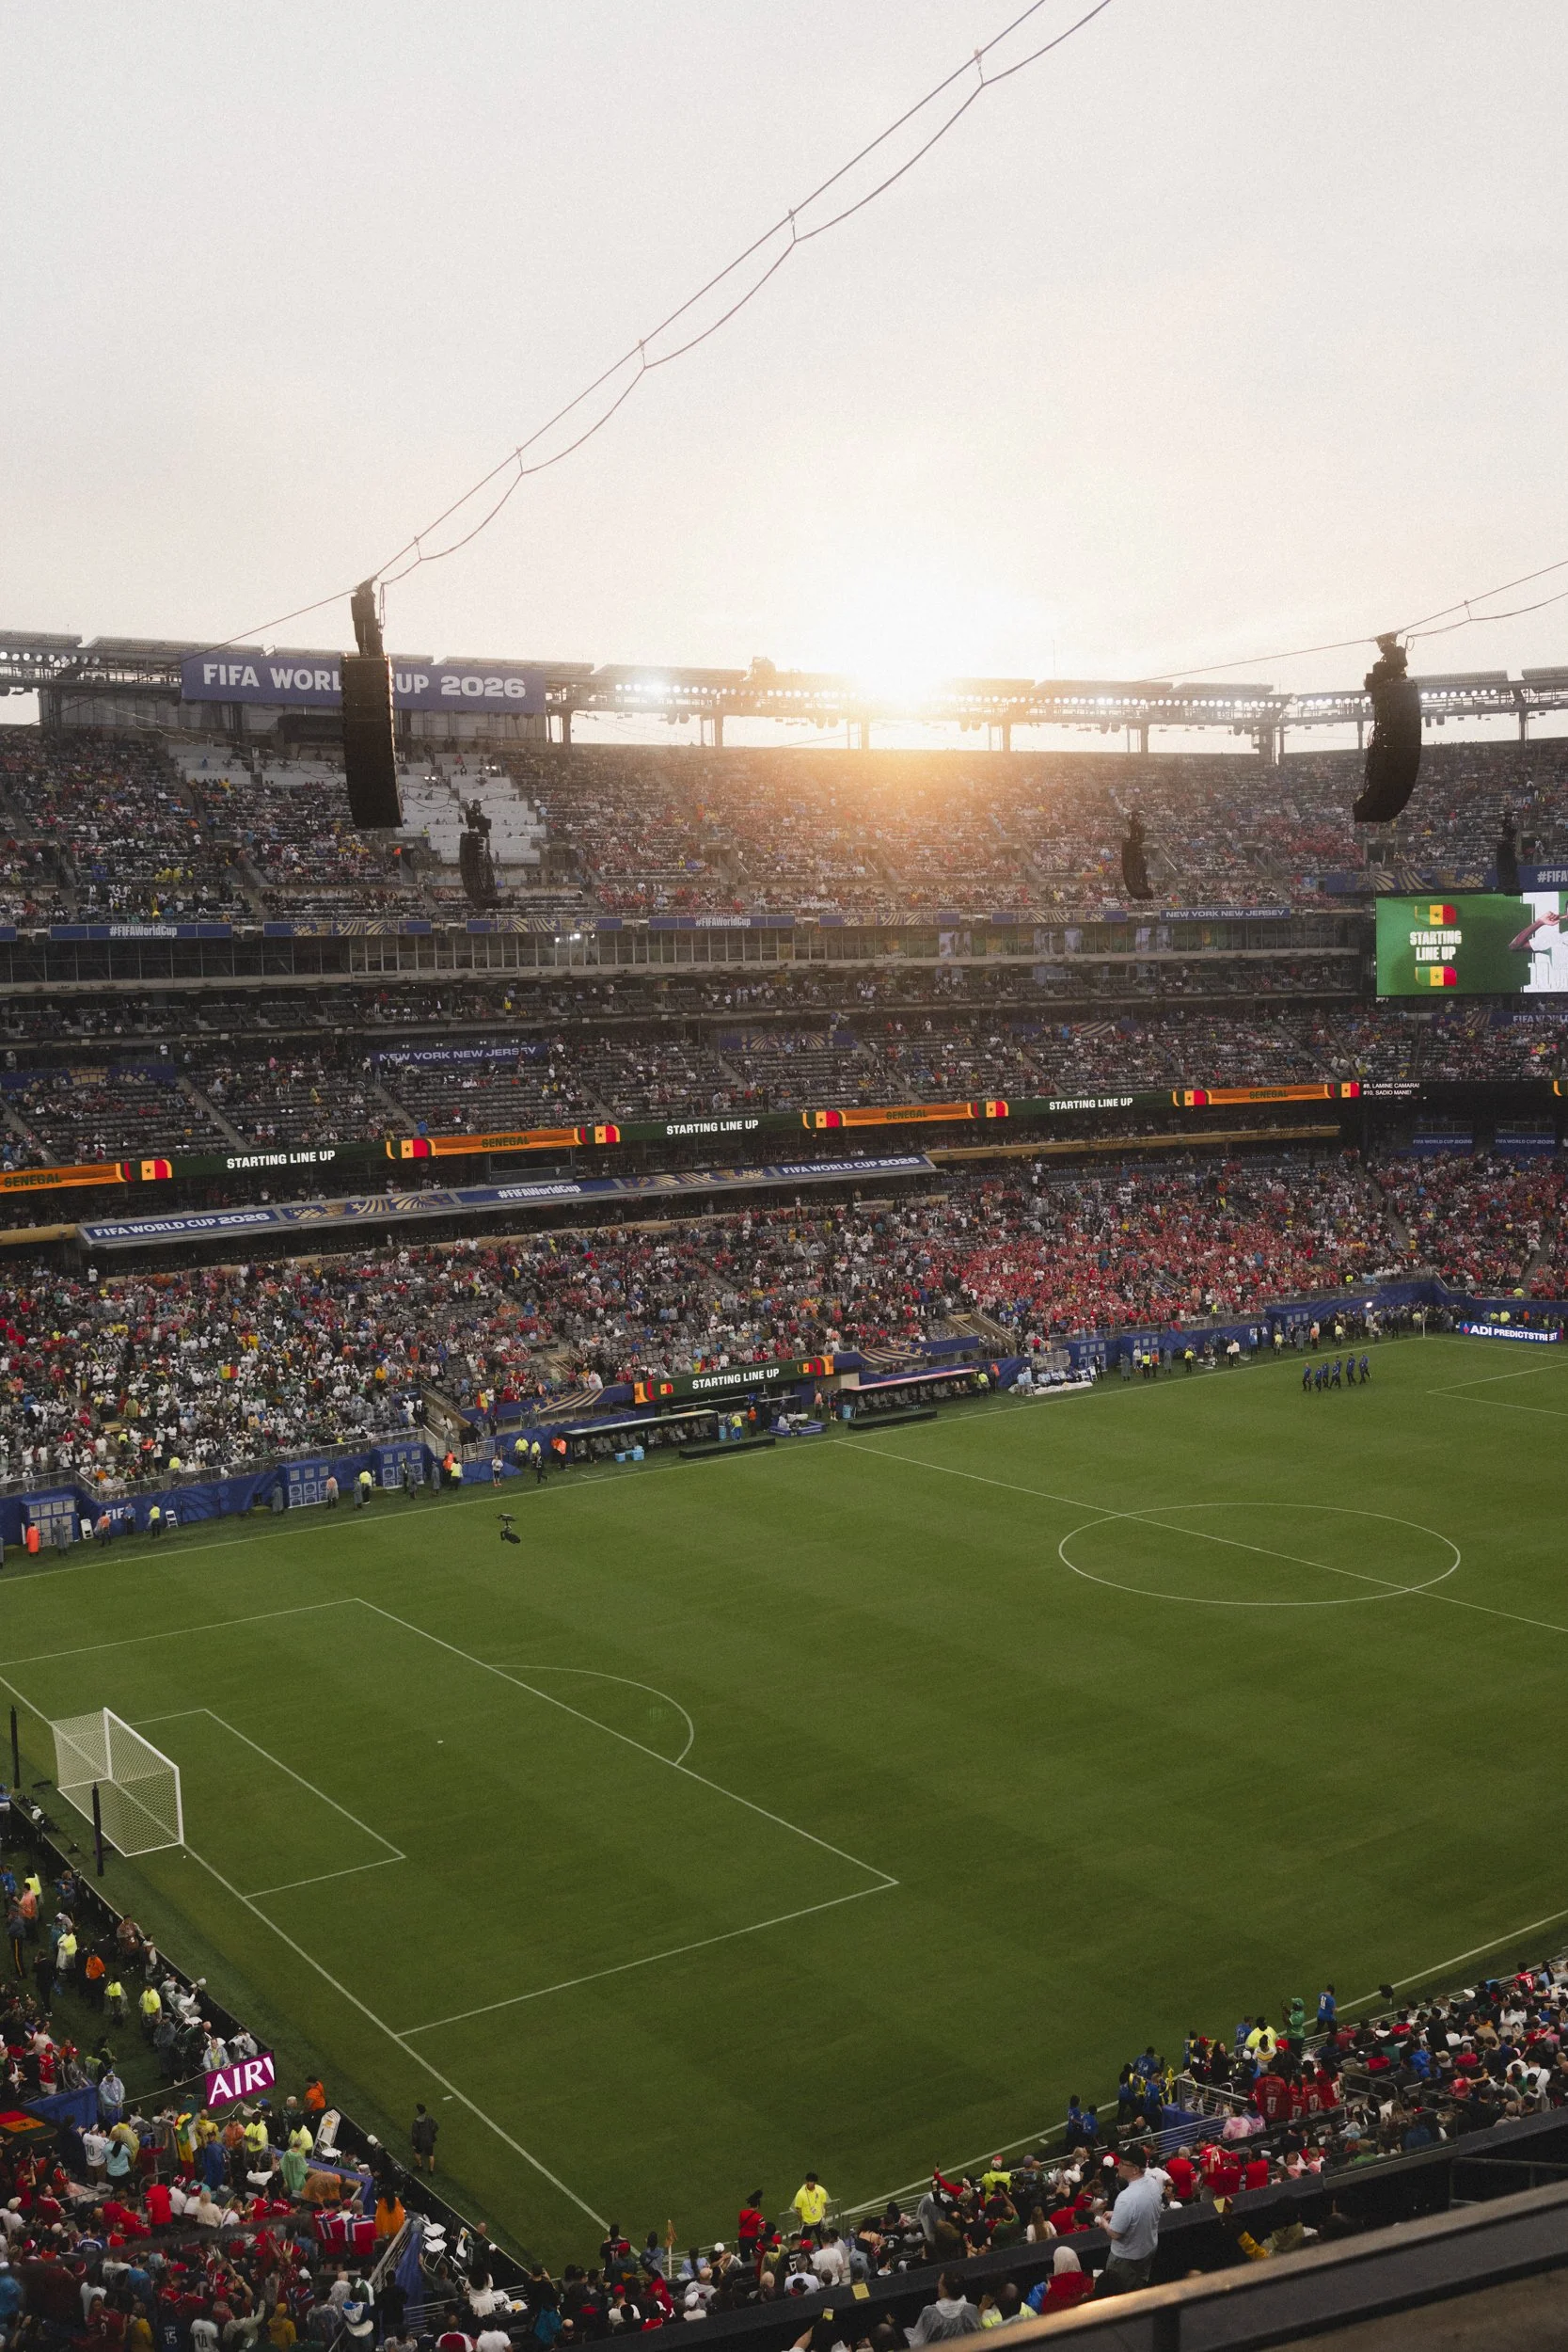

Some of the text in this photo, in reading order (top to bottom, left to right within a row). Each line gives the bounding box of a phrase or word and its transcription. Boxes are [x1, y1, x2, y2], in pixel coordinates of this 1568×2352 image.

[203, 664, 527, 698] FIFA WORL UP 2026
[1537, 869, 1568, 882] #FIFA
[1165, 909, 1285, 918] NEW YORK NEW JERSEY
[695, 916, 752, 929] #FIFAWorldCup
[109, 925, 178, 938] #FIFAWorldCup
[1409, 930, 1462, 946] STARTING
[1416, 946, 1456, 961] LINE UP
[1513, 1015, 1534, 1024] FIFA
[413, 1051, 450, 1060] YORK
[453, 1049, 483, 1059] NEW
[1249, 1089, 1289, 1100] SENEGAL
[1049, 1097, 1133, 1110] STARTING LINE UP
[886, 1109, 927, 1120] SENEGAL
[666, 1120, 759, 1136] STARTING LINE UP
[482, 1136, 530, 1149] SENEGAL
[226, 1150, 336, 1169] STARTING LINE UP
[782, 1157, 921, 1175] FIFA WORLD CUP 2026
[4, 1172, 62, 1188] SENEGAL
[498, 1184, 581, 1200] #FIFAWorldCup
[93, 1213, 270, 1237] FIFA WORLD CUP 2026
[318, 1255, 341, 1263] NEW
[1469, 1325, 1493, 1336] ADI
[692, 1368, 780, 1390] STARTING LINE UP
[105, 1507, 128, 1520] FIF
[165, 2330, 178, 2344] 15
